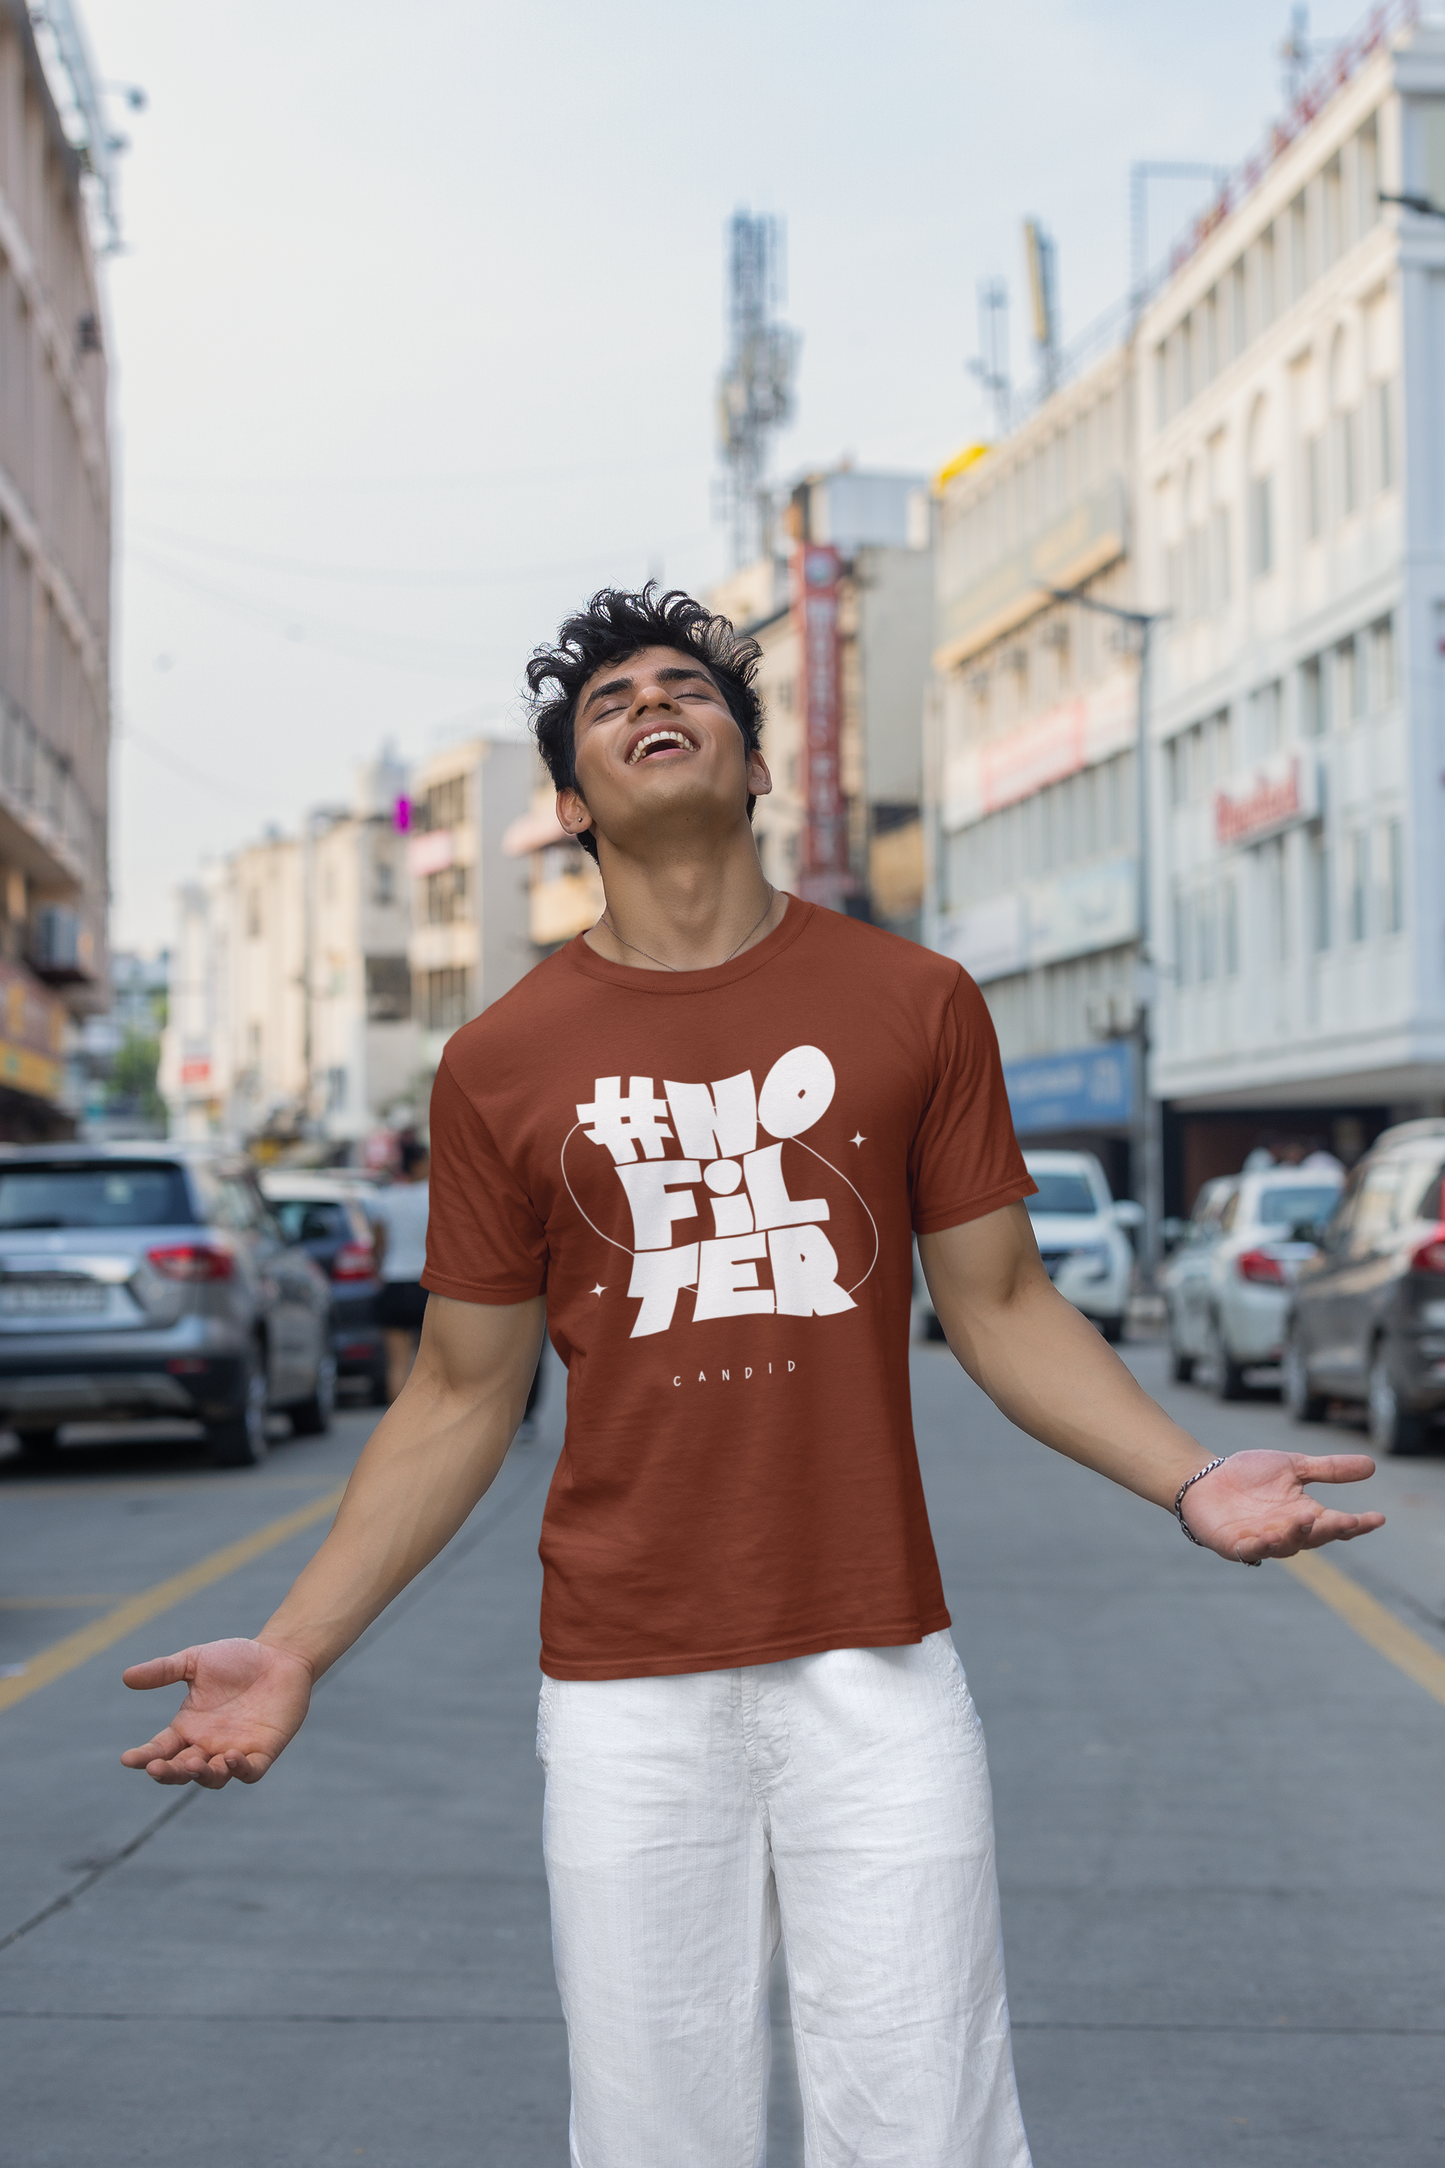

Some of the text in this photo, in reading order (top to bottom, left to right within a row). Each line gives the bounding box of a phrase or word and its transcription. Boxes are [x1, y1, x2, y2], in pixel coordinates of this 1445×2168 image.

[576, 1045, 836, 1165] #NO
[626, 1224, 859, 1339] TER
[673, 1360, 796, 1387] CANDID
